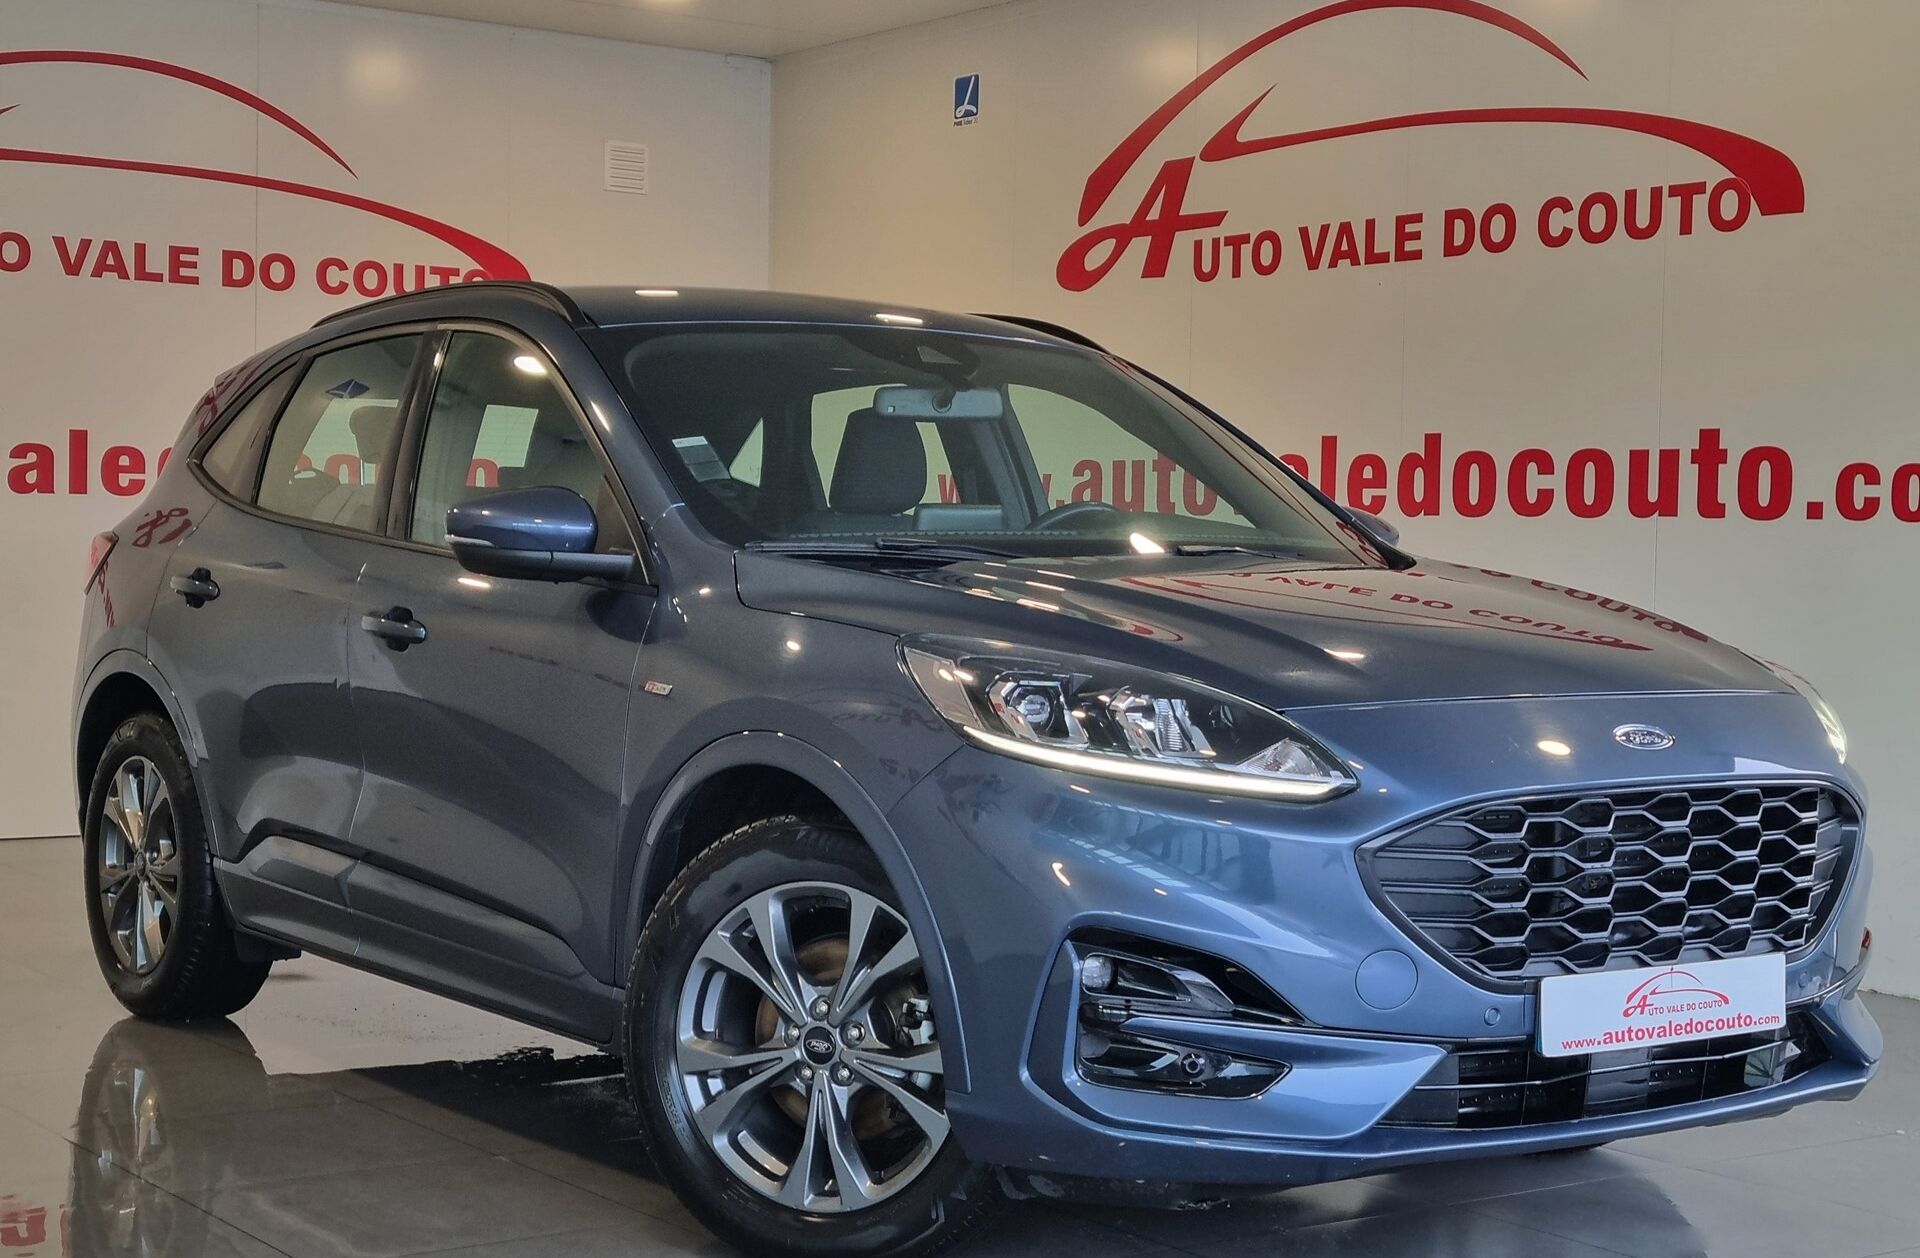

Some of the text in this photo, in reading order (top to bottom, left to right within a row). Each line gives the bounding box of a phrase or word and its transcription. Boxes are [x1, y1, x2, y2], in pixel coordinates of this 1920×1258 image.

[1298, 213, 1424, 271] VALE
[1443, 203, 1517, 258] DO
[1537, 178, 1751, 248] COUTO
[51, 235, 200, 285] VALE
[221, 249, 296, 292] DO
[1666, 1004, 1685, 1015] VALE
[1686, 1002, 1697, 1012] DO
[1698, 999, 1722, 1010] COUTO
[1561, 1012, 1780, 1050] www.autovaledocouto.com
